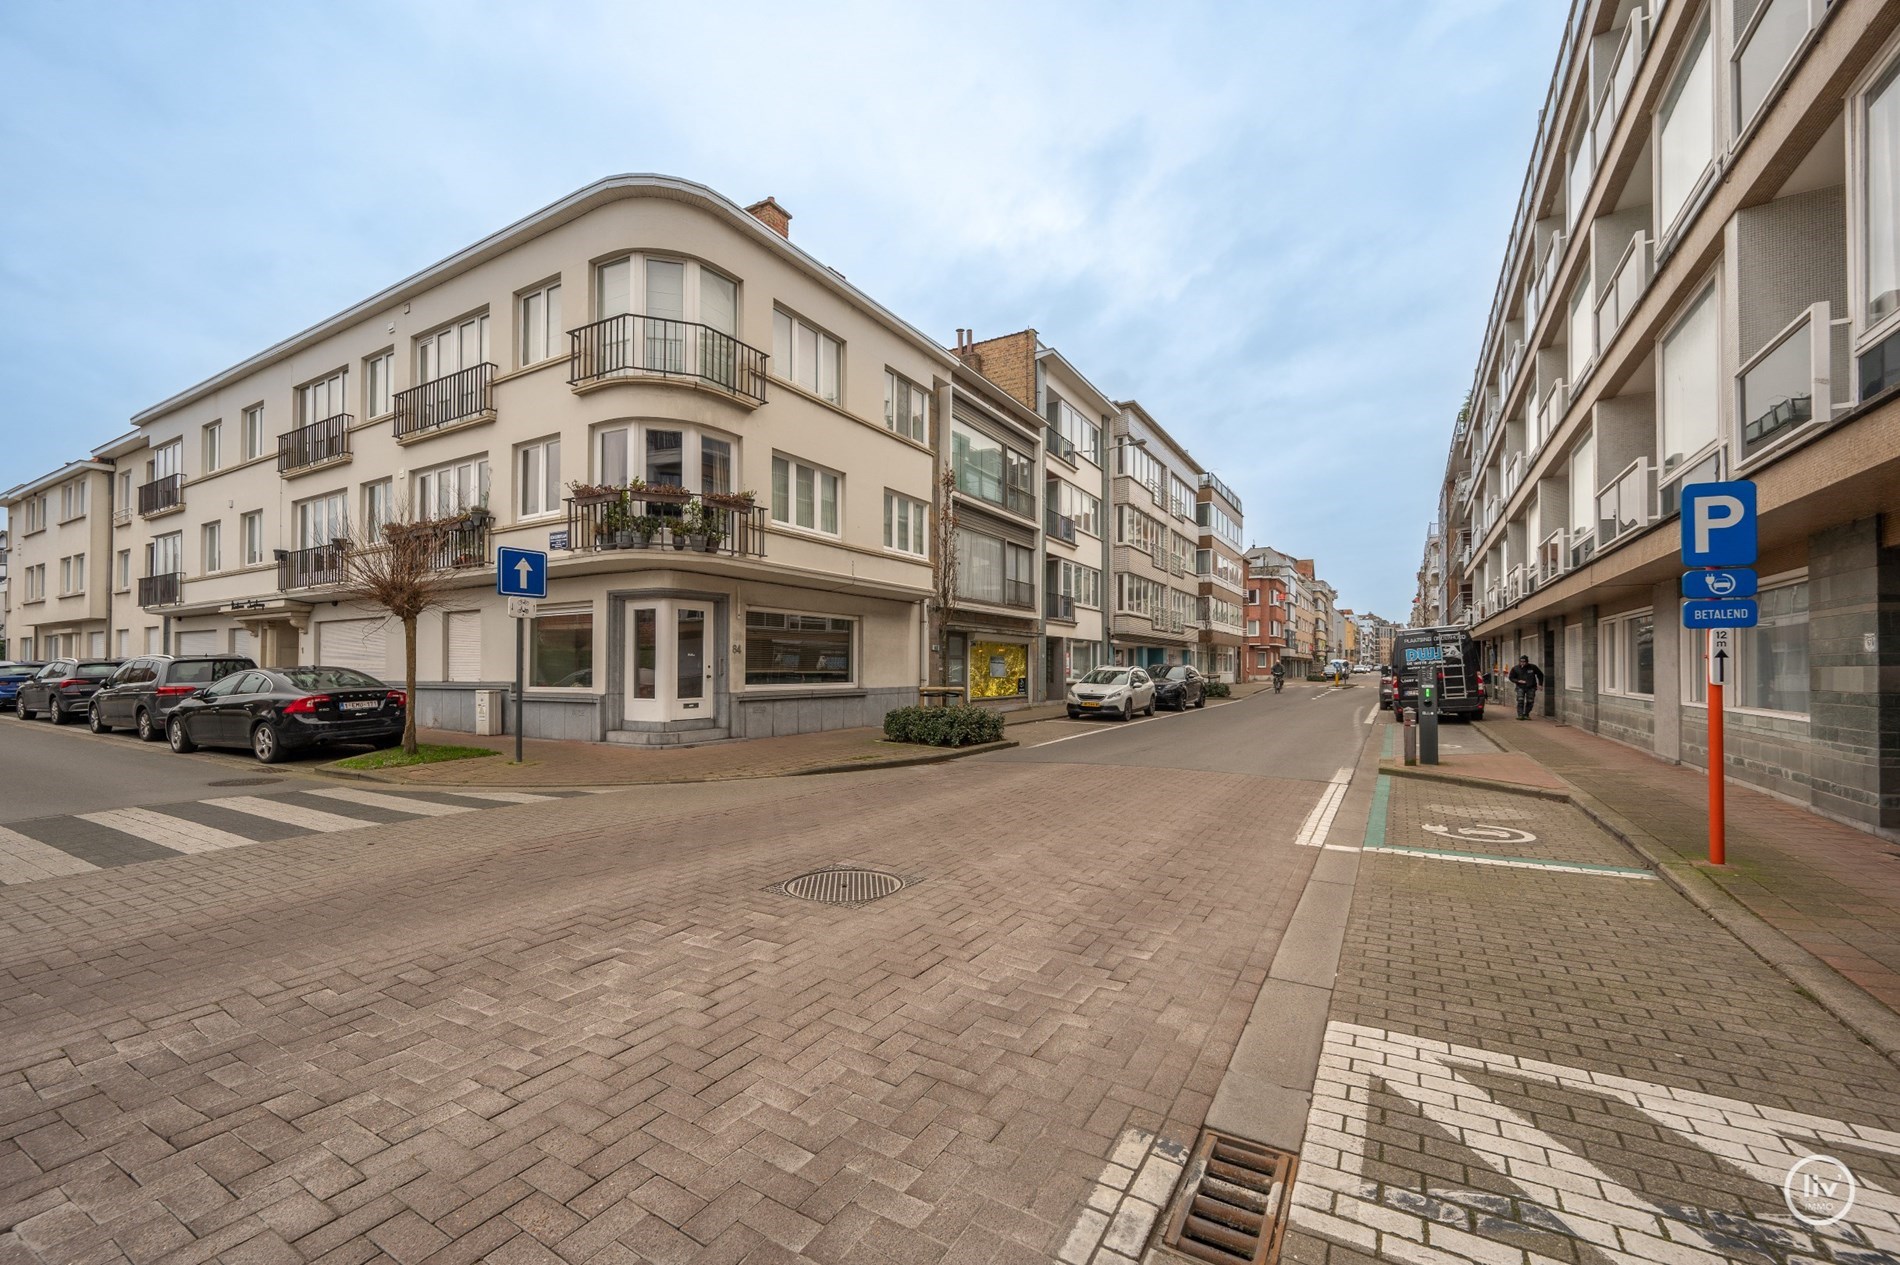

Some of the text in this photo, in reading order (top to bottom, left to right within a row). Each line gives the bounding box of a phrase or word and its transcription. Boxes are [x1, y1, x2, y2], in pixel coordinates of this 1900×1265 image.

[1694, 495, 1745, 554] P
[1694, 608, 1749, 620] BETALEND
[1715, 630, 1728, 640] 12
[732, 644, 742, 655] 84
